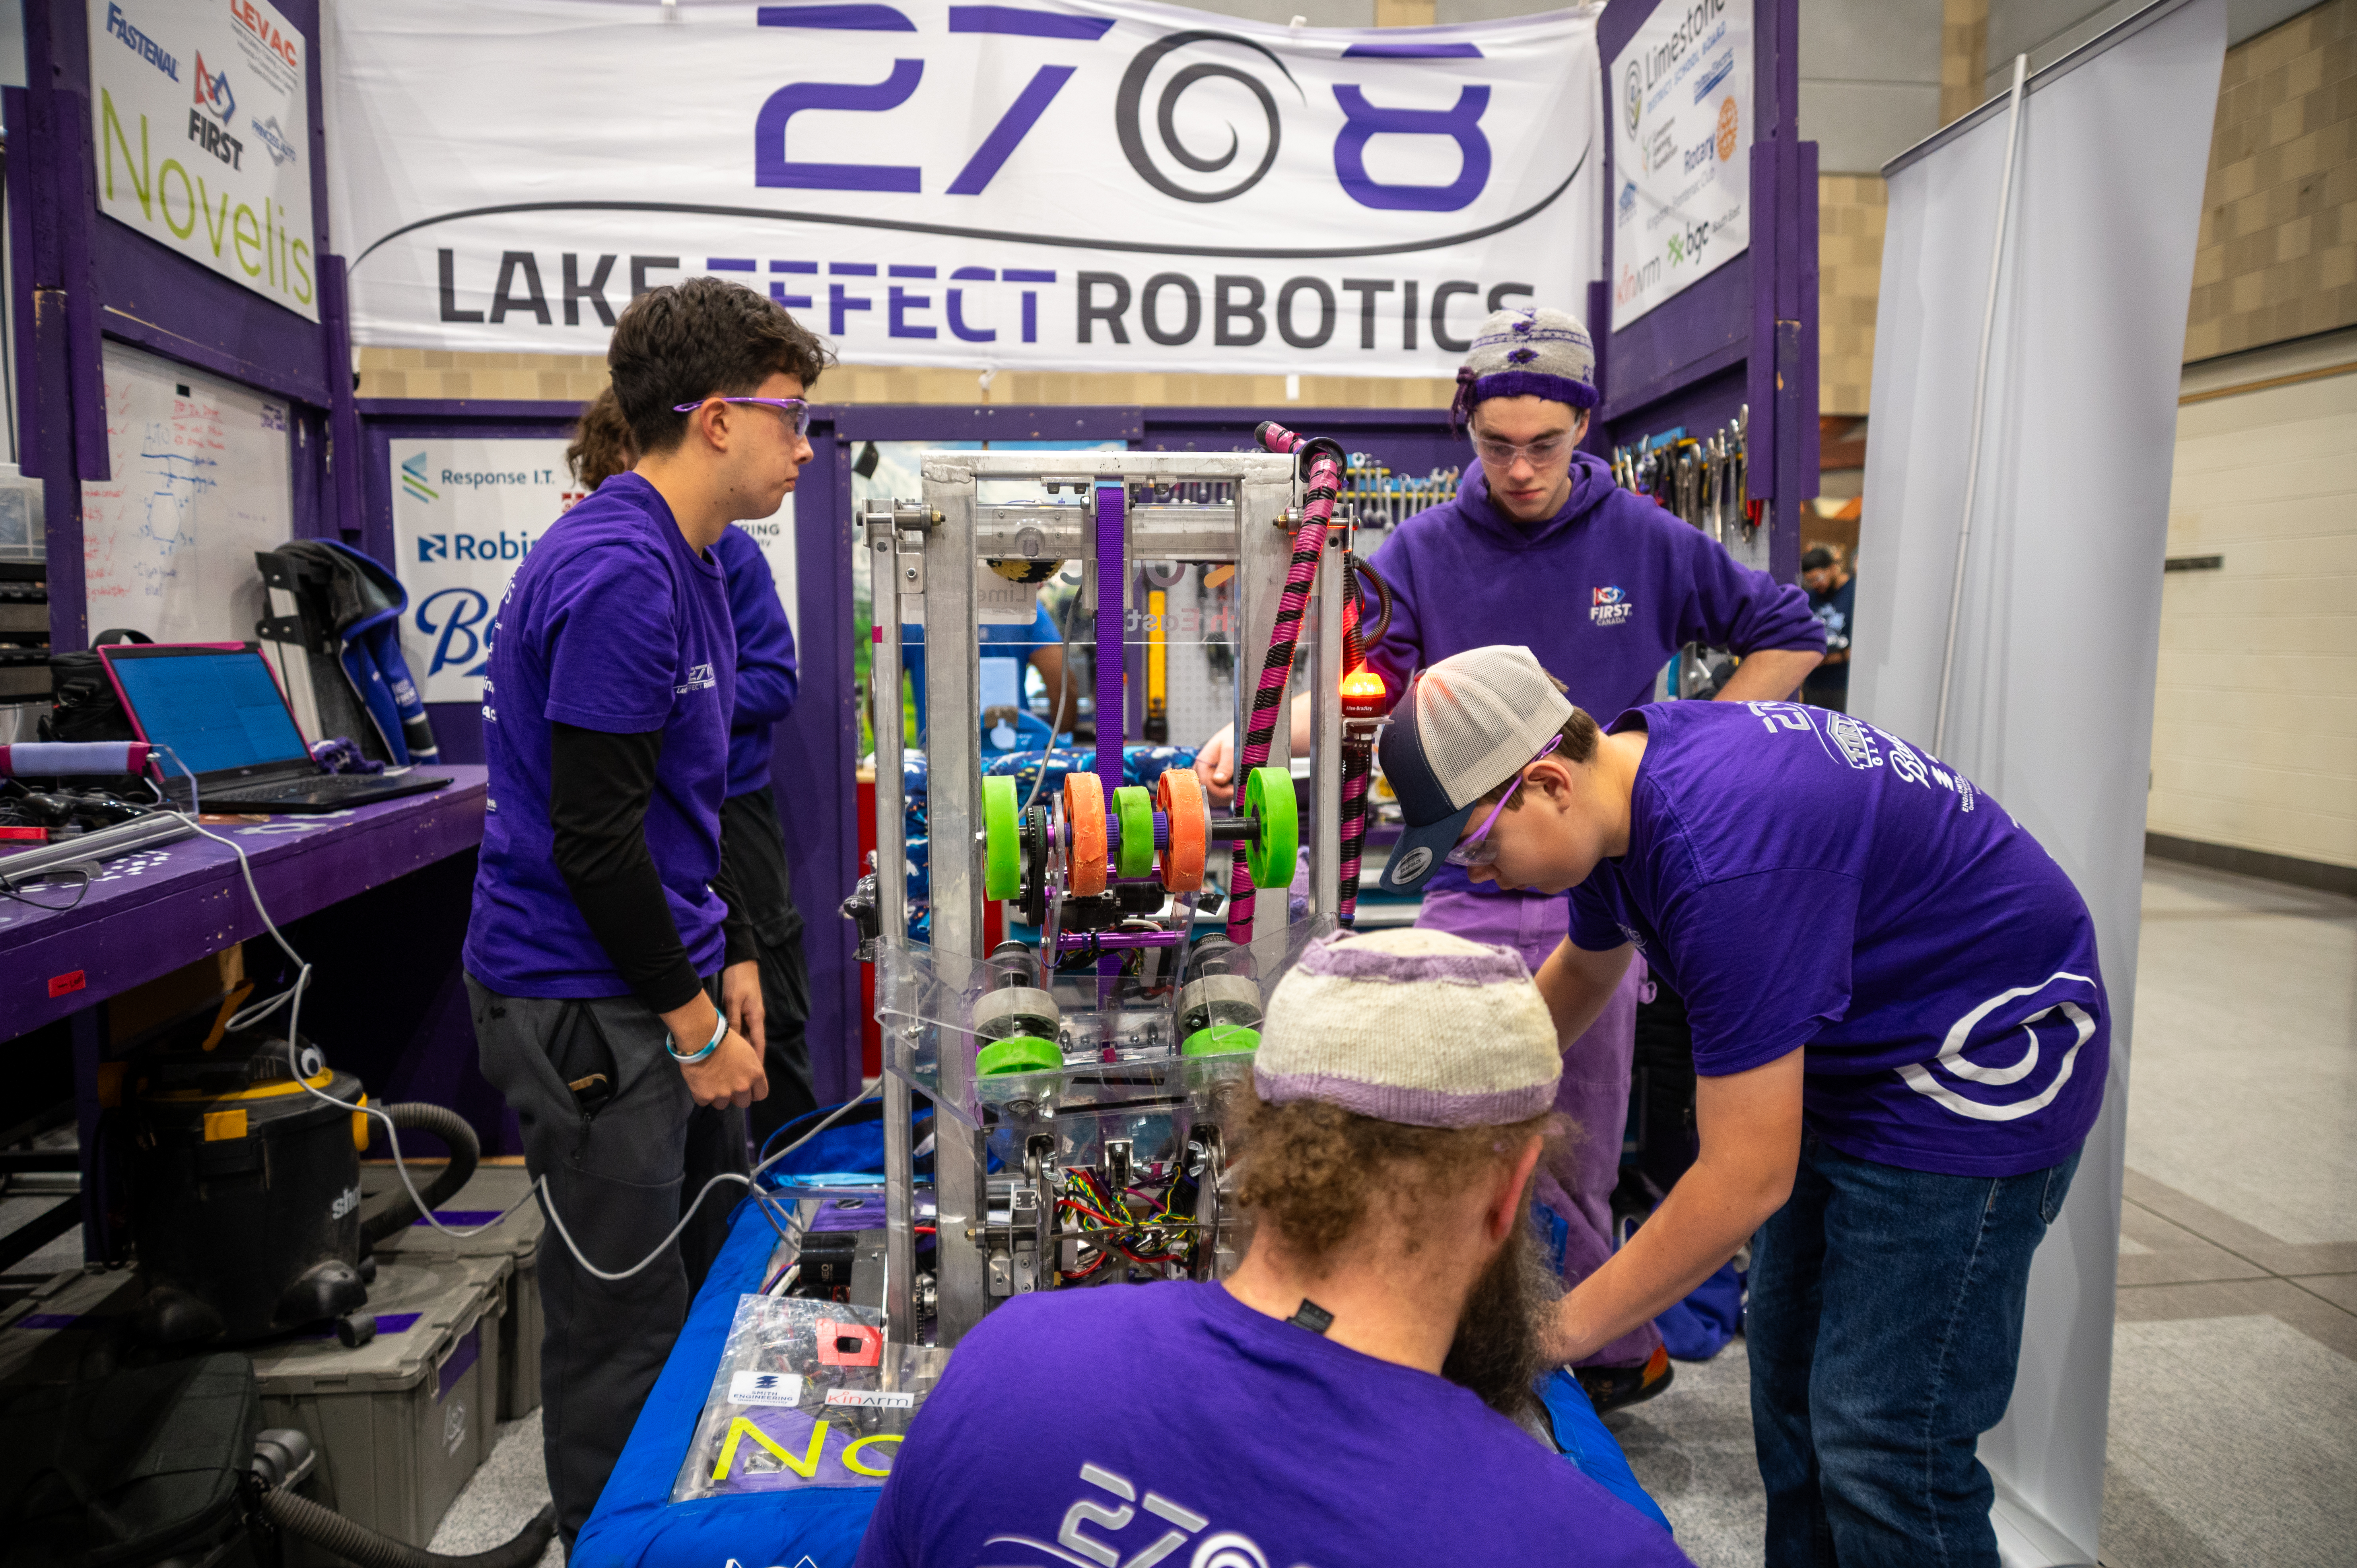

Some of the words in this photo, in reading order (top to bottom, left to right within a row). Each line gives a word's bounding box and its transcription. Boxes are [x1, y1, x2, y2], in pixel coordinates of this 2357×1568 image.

[106, 1, 180, 83] FASTENAL
[188, 108, 243, 171] FIRST
[1685, 132, 1715, 177] Rotary
[101, 87, 312, 305] Novelis
[1687, 222, 1709, 266] bgc
[707, 258, 1056, 342] FFECT
[442, 469, 526, 490] Response
[534, 469, 555, 484] I.T.
[1590, 603, 1632, 620] FIRST
[1596, 616, 1626, 626] CANADA
[1400, 858, 1422, 874] SNAPBACK
[733, 1393, 793, 1402] ENGINEERING
